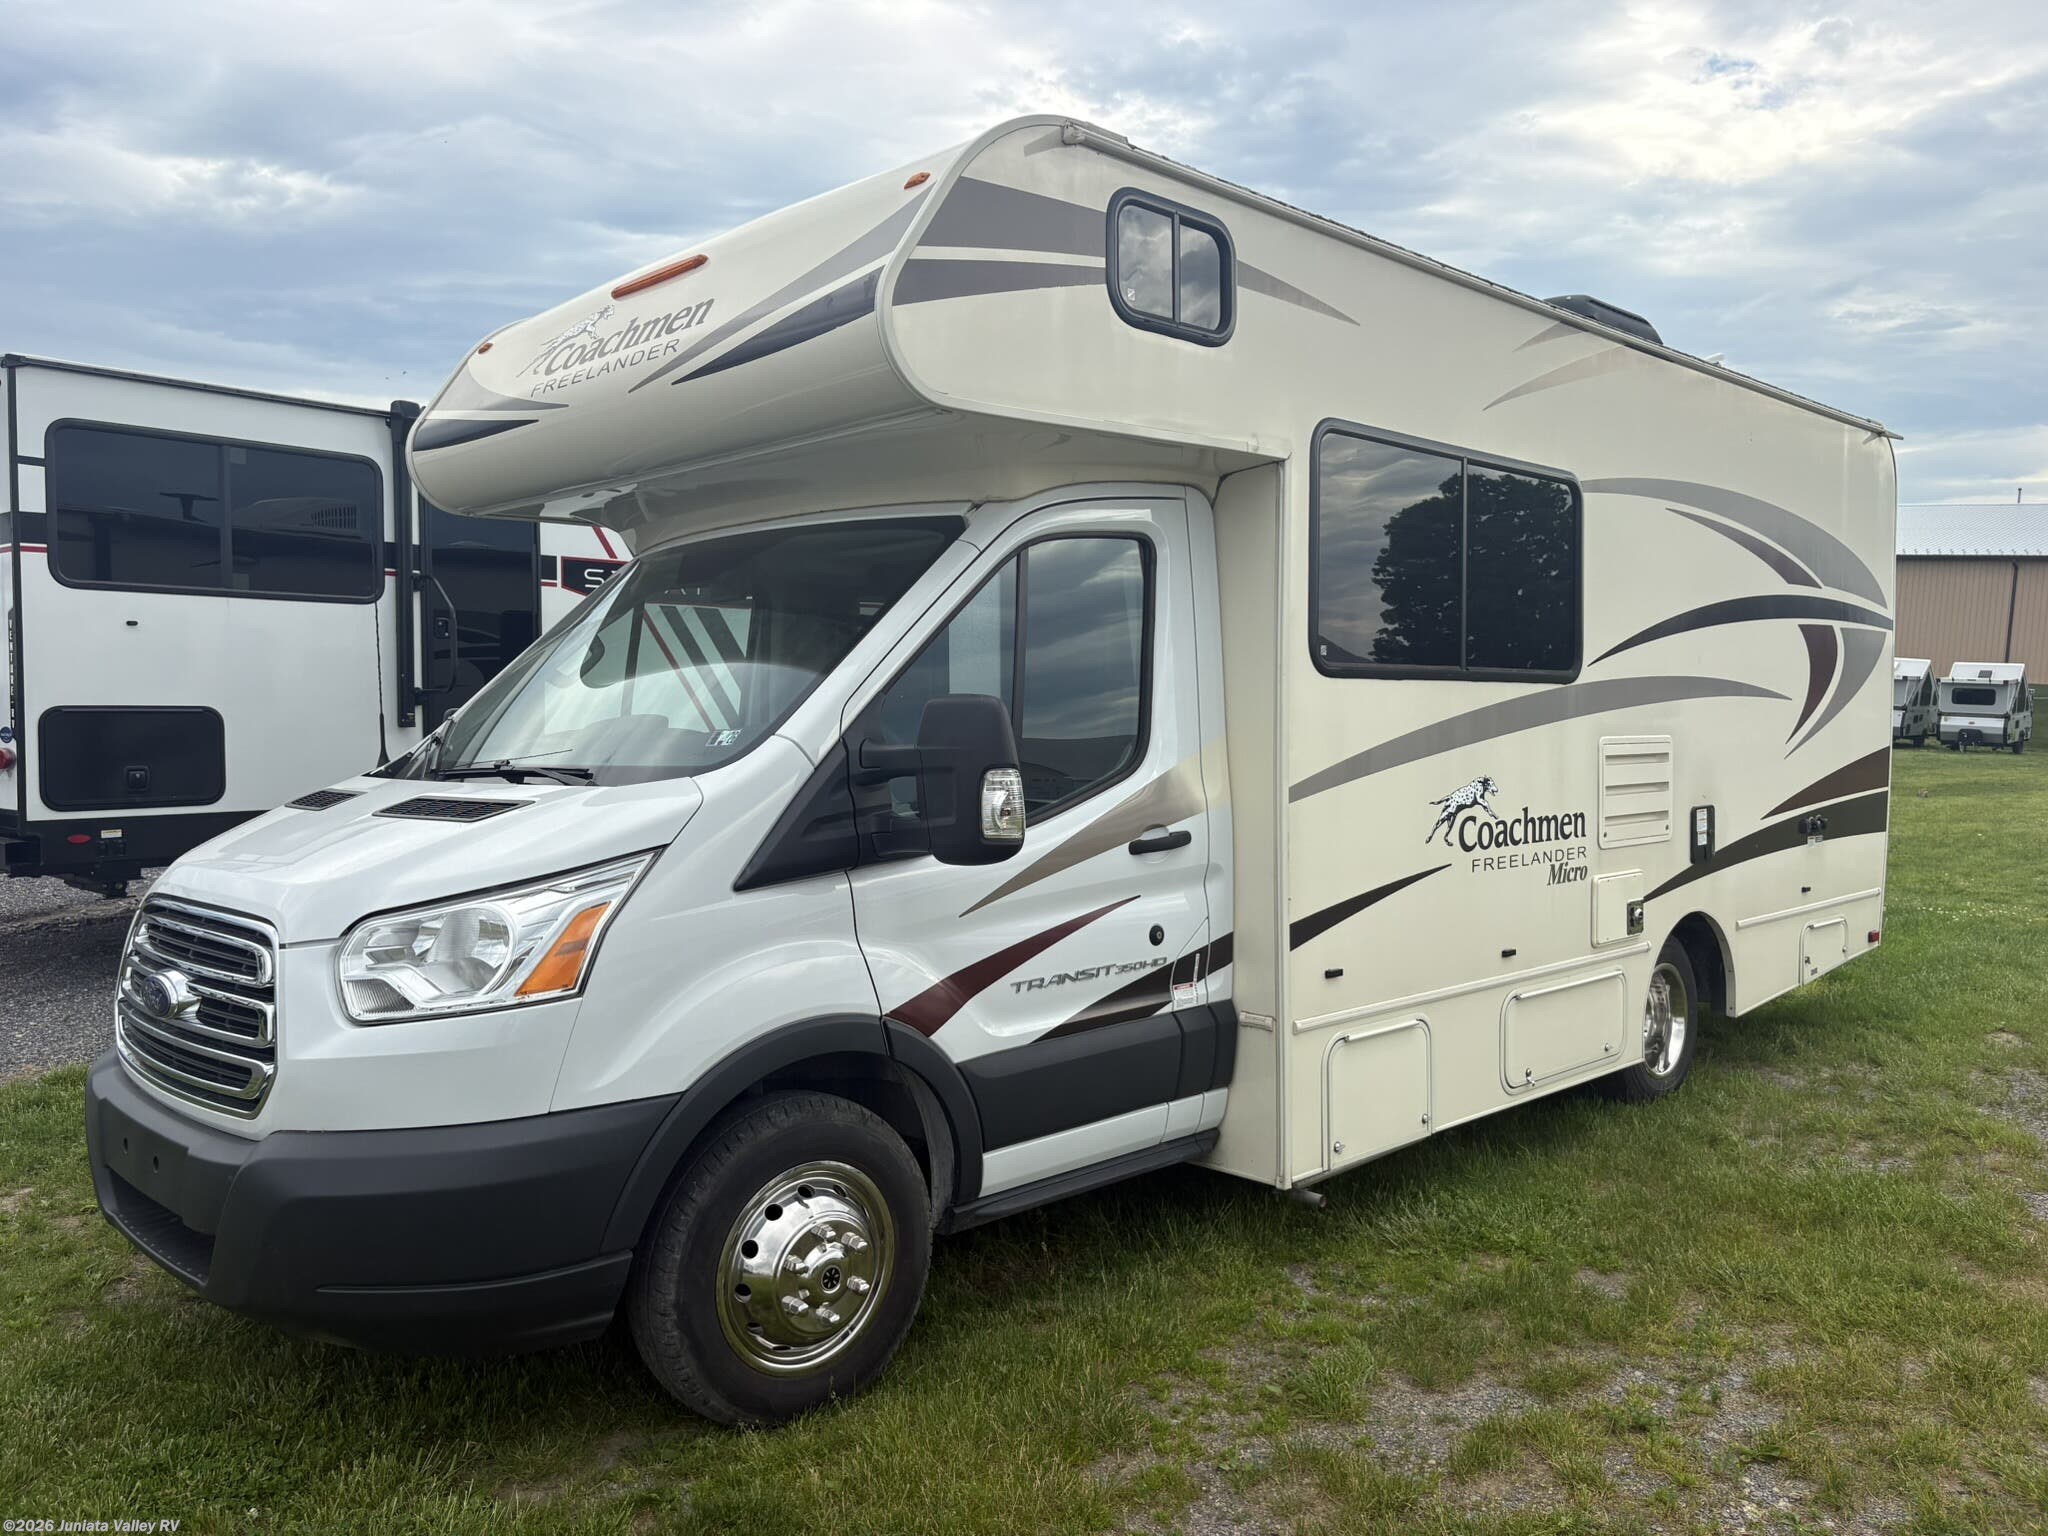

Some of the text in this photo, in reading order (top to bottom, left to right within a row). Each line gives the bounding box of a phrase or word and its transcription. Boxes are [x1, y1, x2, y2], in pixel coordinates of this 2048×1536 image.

[545, 298, 715, 376] Coachmen
[530, 338, 680, 398] FREELANDER
[584, 568, 617, 588] S
[1458, 806, 1587, 853] Coachmen
[1471, 846, 1587, 873] FREELANDER
[1546, 862, 1588, 886] Micro
[1010, 963, 1116, 994] TRANSIT
